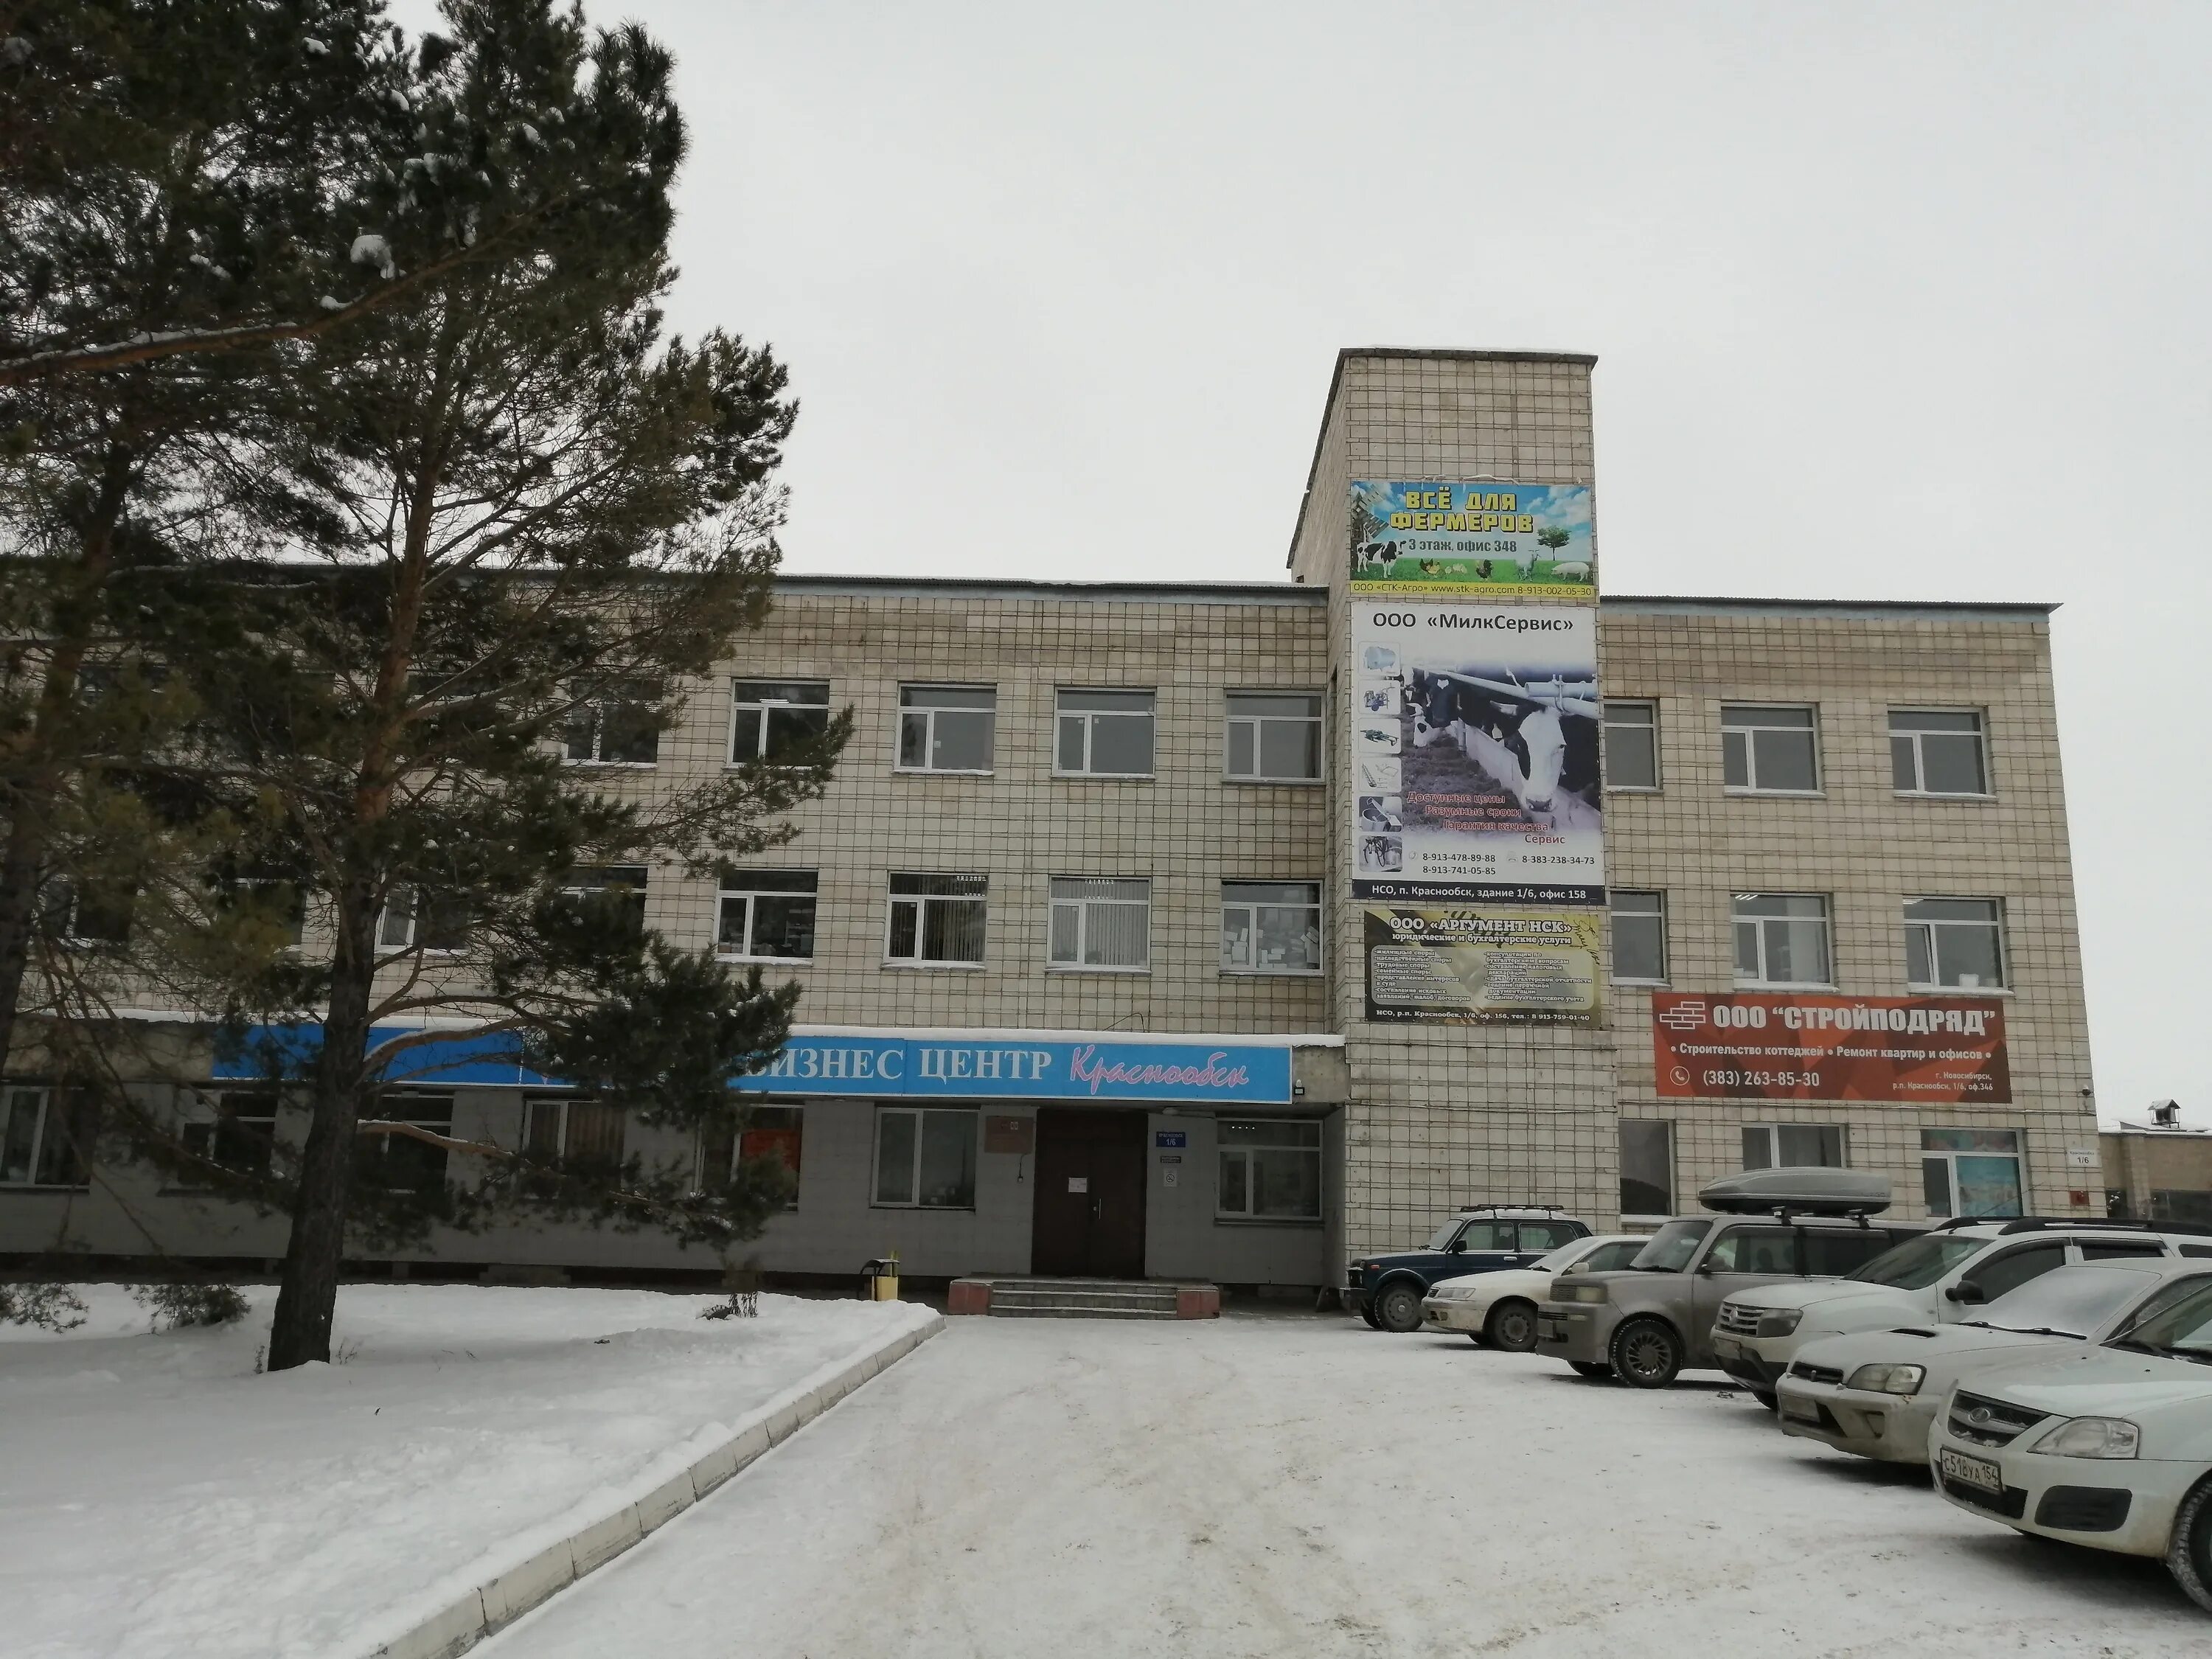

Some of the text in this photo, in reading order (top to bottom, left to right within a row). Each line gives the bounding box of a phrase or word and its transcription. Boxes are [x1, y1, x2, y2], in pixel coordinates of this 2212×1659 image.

[1406, 486, 1517, 511] ВСЁ ДЛЯ
[1390, 511, 1534, 532] ФЕРМЕРОВ
[1408, 539, 1517, 552] 3 этаж, офис 348
[1354, 583, 1591, 596] ООО «СТК-Агро» www.stk-agro.com 8-913-002-05-30
[1373, 613, 1573, 633] ООО «МилкСервис»
[1407, 792, 1505, 805] Доступные цены
[1425, 805, 1522, 818] Разумные сроки
[1443, 820, 1548, 832] Гарантия качества
[1525, 834, 1565, 845] Сервис
[1422, 852, 1496, 863] 8-913-478-89-88
[1522, 855, 1595, 865] 8-383-238-34-73
[1422, 866, 1496, 875] 8-913-741-05-85
[1371, 885, 1397, 896] НСО,
[1411, 886, 1475, 898] Краснообск,
[1477, 889, 1514, 898] здание
[1517, 888, 1537, 900] 1/6,
[1539, 890, 1566, 901] офис
[1568, 890, 1587, 899] 158
[1390, 917, 1573, 933] ООО «АРГУМЕНТ НСК»
[1392, 933, 1457, 942] юридические
[1467, 933, 1537, 945] бухгалтерские
[1538, 936, 1572, 946] услуги
[1414, 1010, 1461, 1019] Краснообск,
[1714, 1005, 1767, 1029] ООО
[1680, 1043, 1824, 1057] Строительство коттеджей
[1837, 1046, 1983, 1061] Ремонт квартир и офисов
[919, 1048, 1052, 1085] ЦЕНТР
[1071, 1045, 1249, 1095] Краснообск
[1944, 1071, 1992, 1081] Новосибирск,
[1703, 1070, 1820, 1087] (383) 263-85-30
[1907, 1082, 1951, 1091] Краснообск,
[1953, 1083, 1966, 1091] 1/6,
[1968, 1083, 1994, 1092] оф.346
